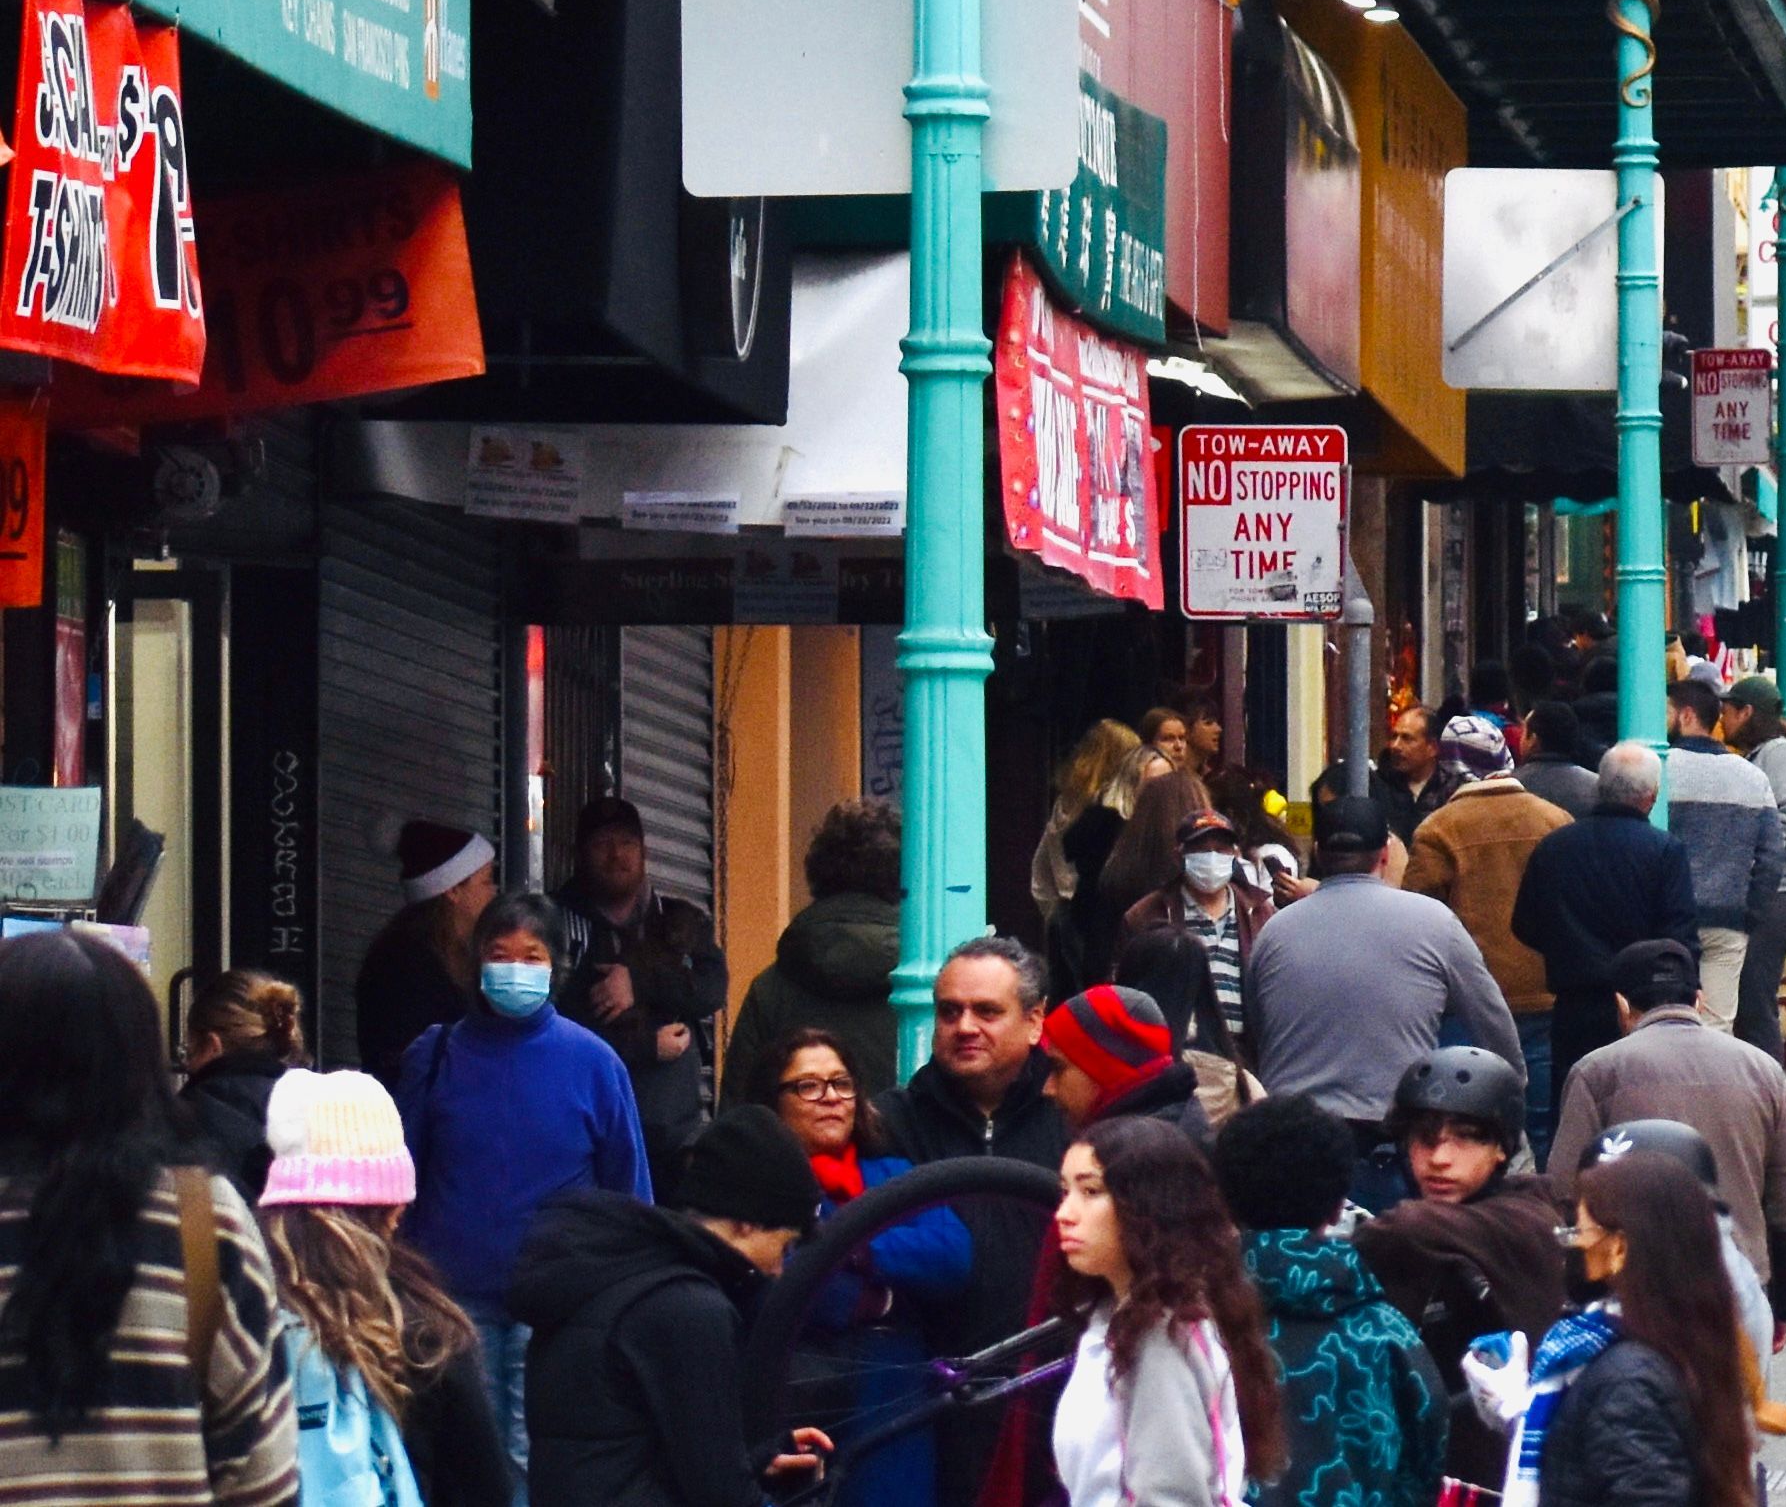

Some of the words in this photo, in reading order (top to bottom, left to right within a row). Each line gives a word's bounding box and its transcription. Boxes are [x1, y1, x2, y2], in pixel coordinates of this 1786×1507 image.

[1701, 352, 1765, 367] TOW-AWAY
[1696, 372, 1718, 394] NO
[1715, 401, 1749, 418] ANY
[1712, 423, 1751, 440] TIME
[1196, 434, 1330, 457] TOW-AWAY
[1188, 459, 1227, 501] NO
[1236, 471, 1336, 502] STOPPING
[1233, 512, 1294, 542] ANY
